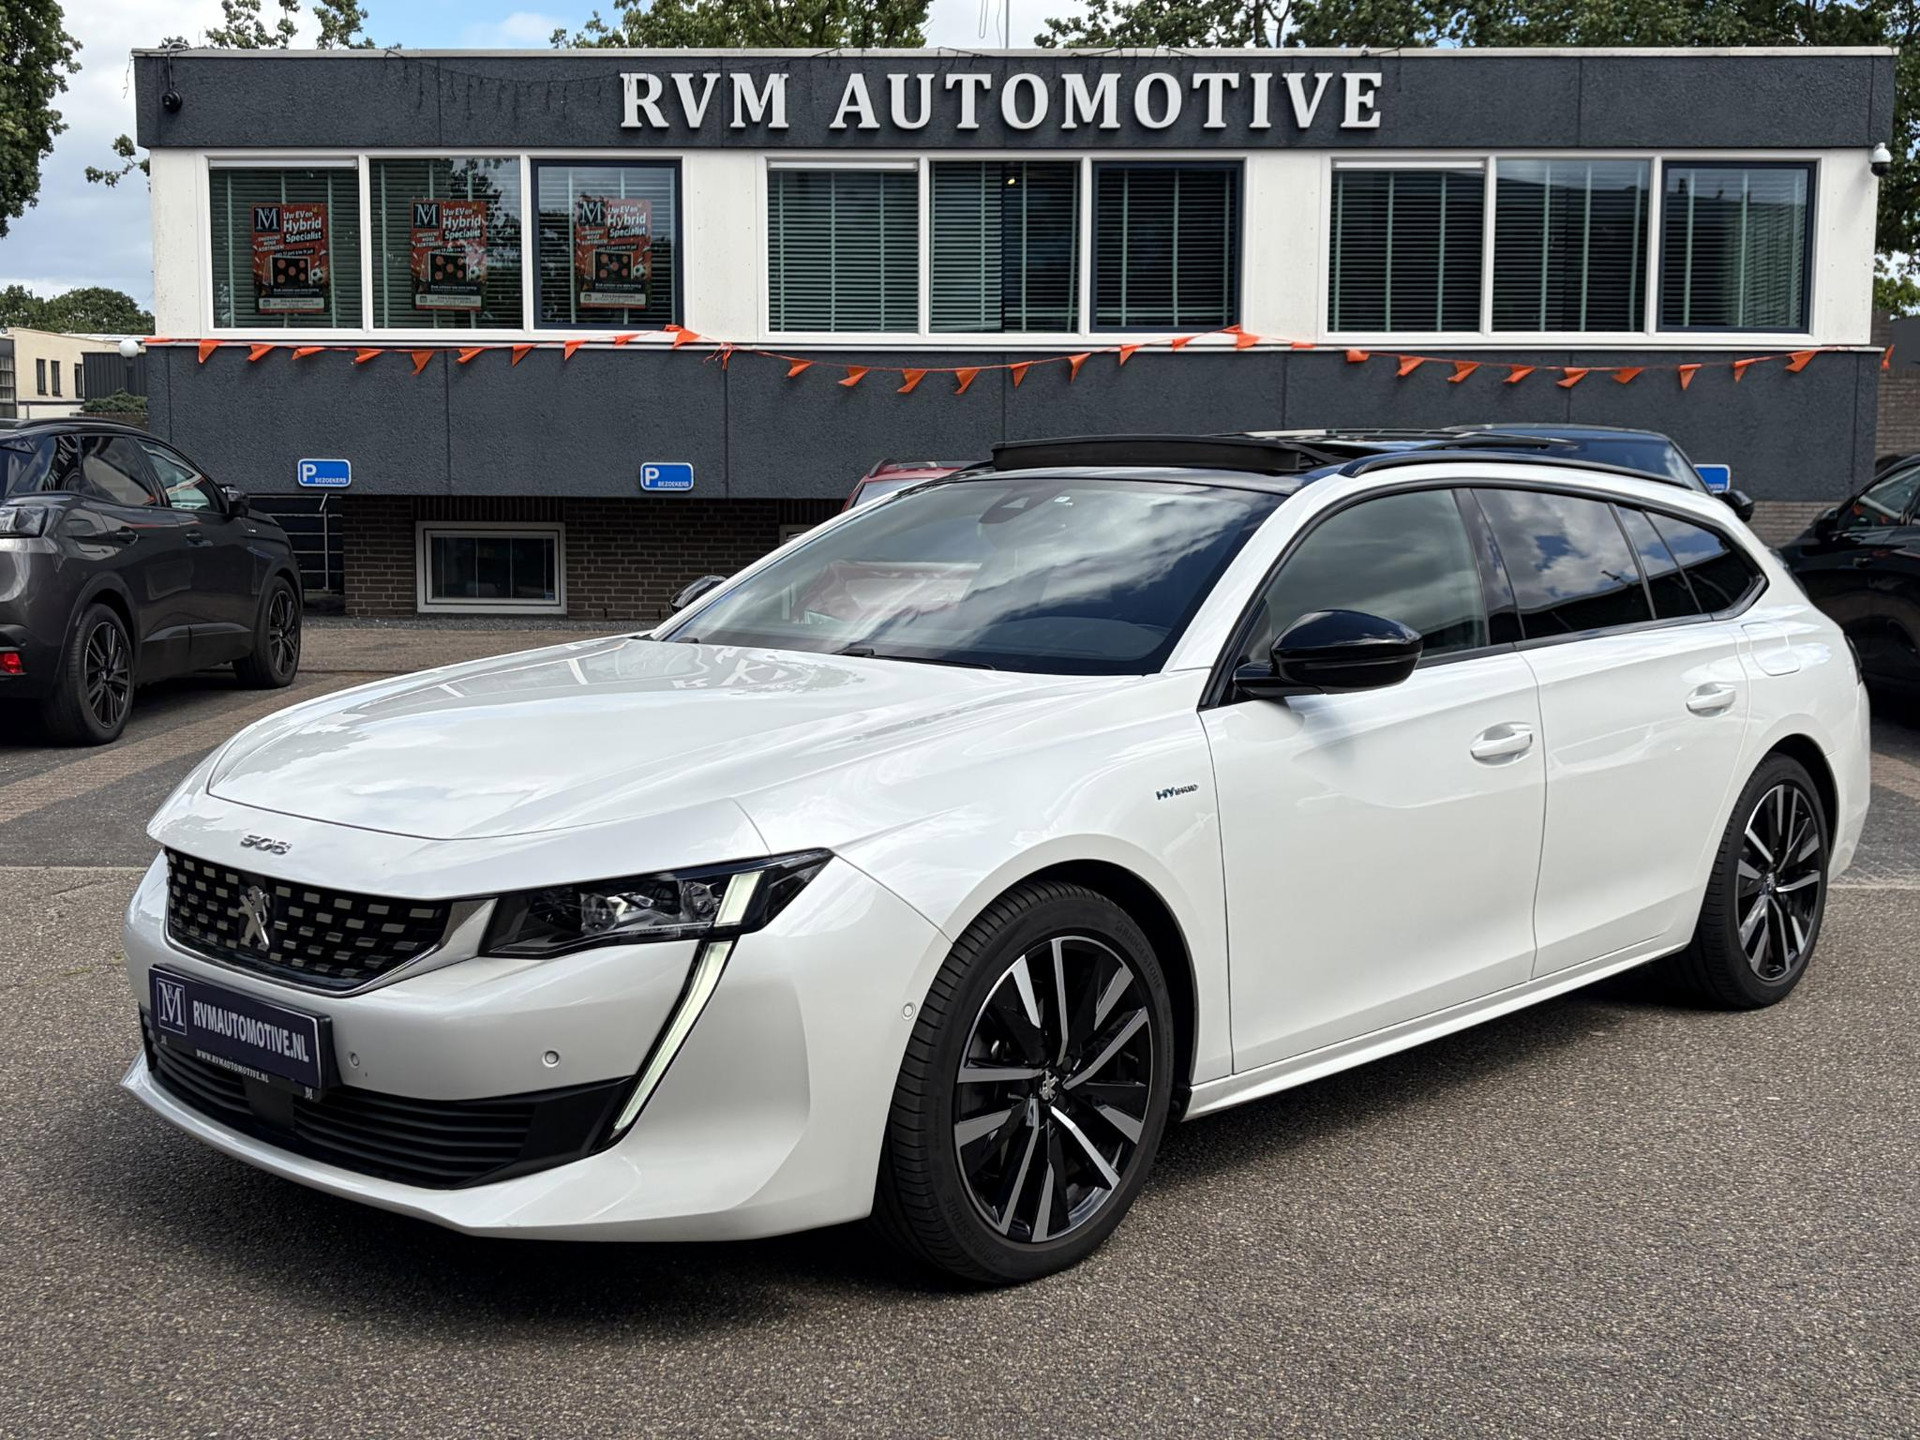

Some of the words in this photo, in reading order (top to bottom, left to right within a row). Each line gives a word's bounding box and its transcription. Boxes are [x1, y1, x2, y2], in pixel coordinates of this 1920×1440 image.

[620, 72, 790, 130] RVM
[829, 72, 1383, 130] AUTOMOTIVE
[295, 210, 305, 218] EV
[455, 207, 465, 215] EV
[620, 204, 630, 212] EV
[283, 216, 322, 234] Hybrid
[442, 213, 482, 231] Hybrid
[607, 212, 647, 228] Hybrid
[286, 231, 322, 243] Specialist
[444, 229, 481, 240] Specialist
[609, 226, 646, 238] Specialist
[302, 464, 317, 482] P
[644, 467, 660, 486] P
[240, 834, 291, 856] 508
[192, 1000, 310, 1063] RVMAUTOMOTIVE.NL
[196, 1049, 270, 1083] WWW.RVMAUTOMOTIVE.NL
